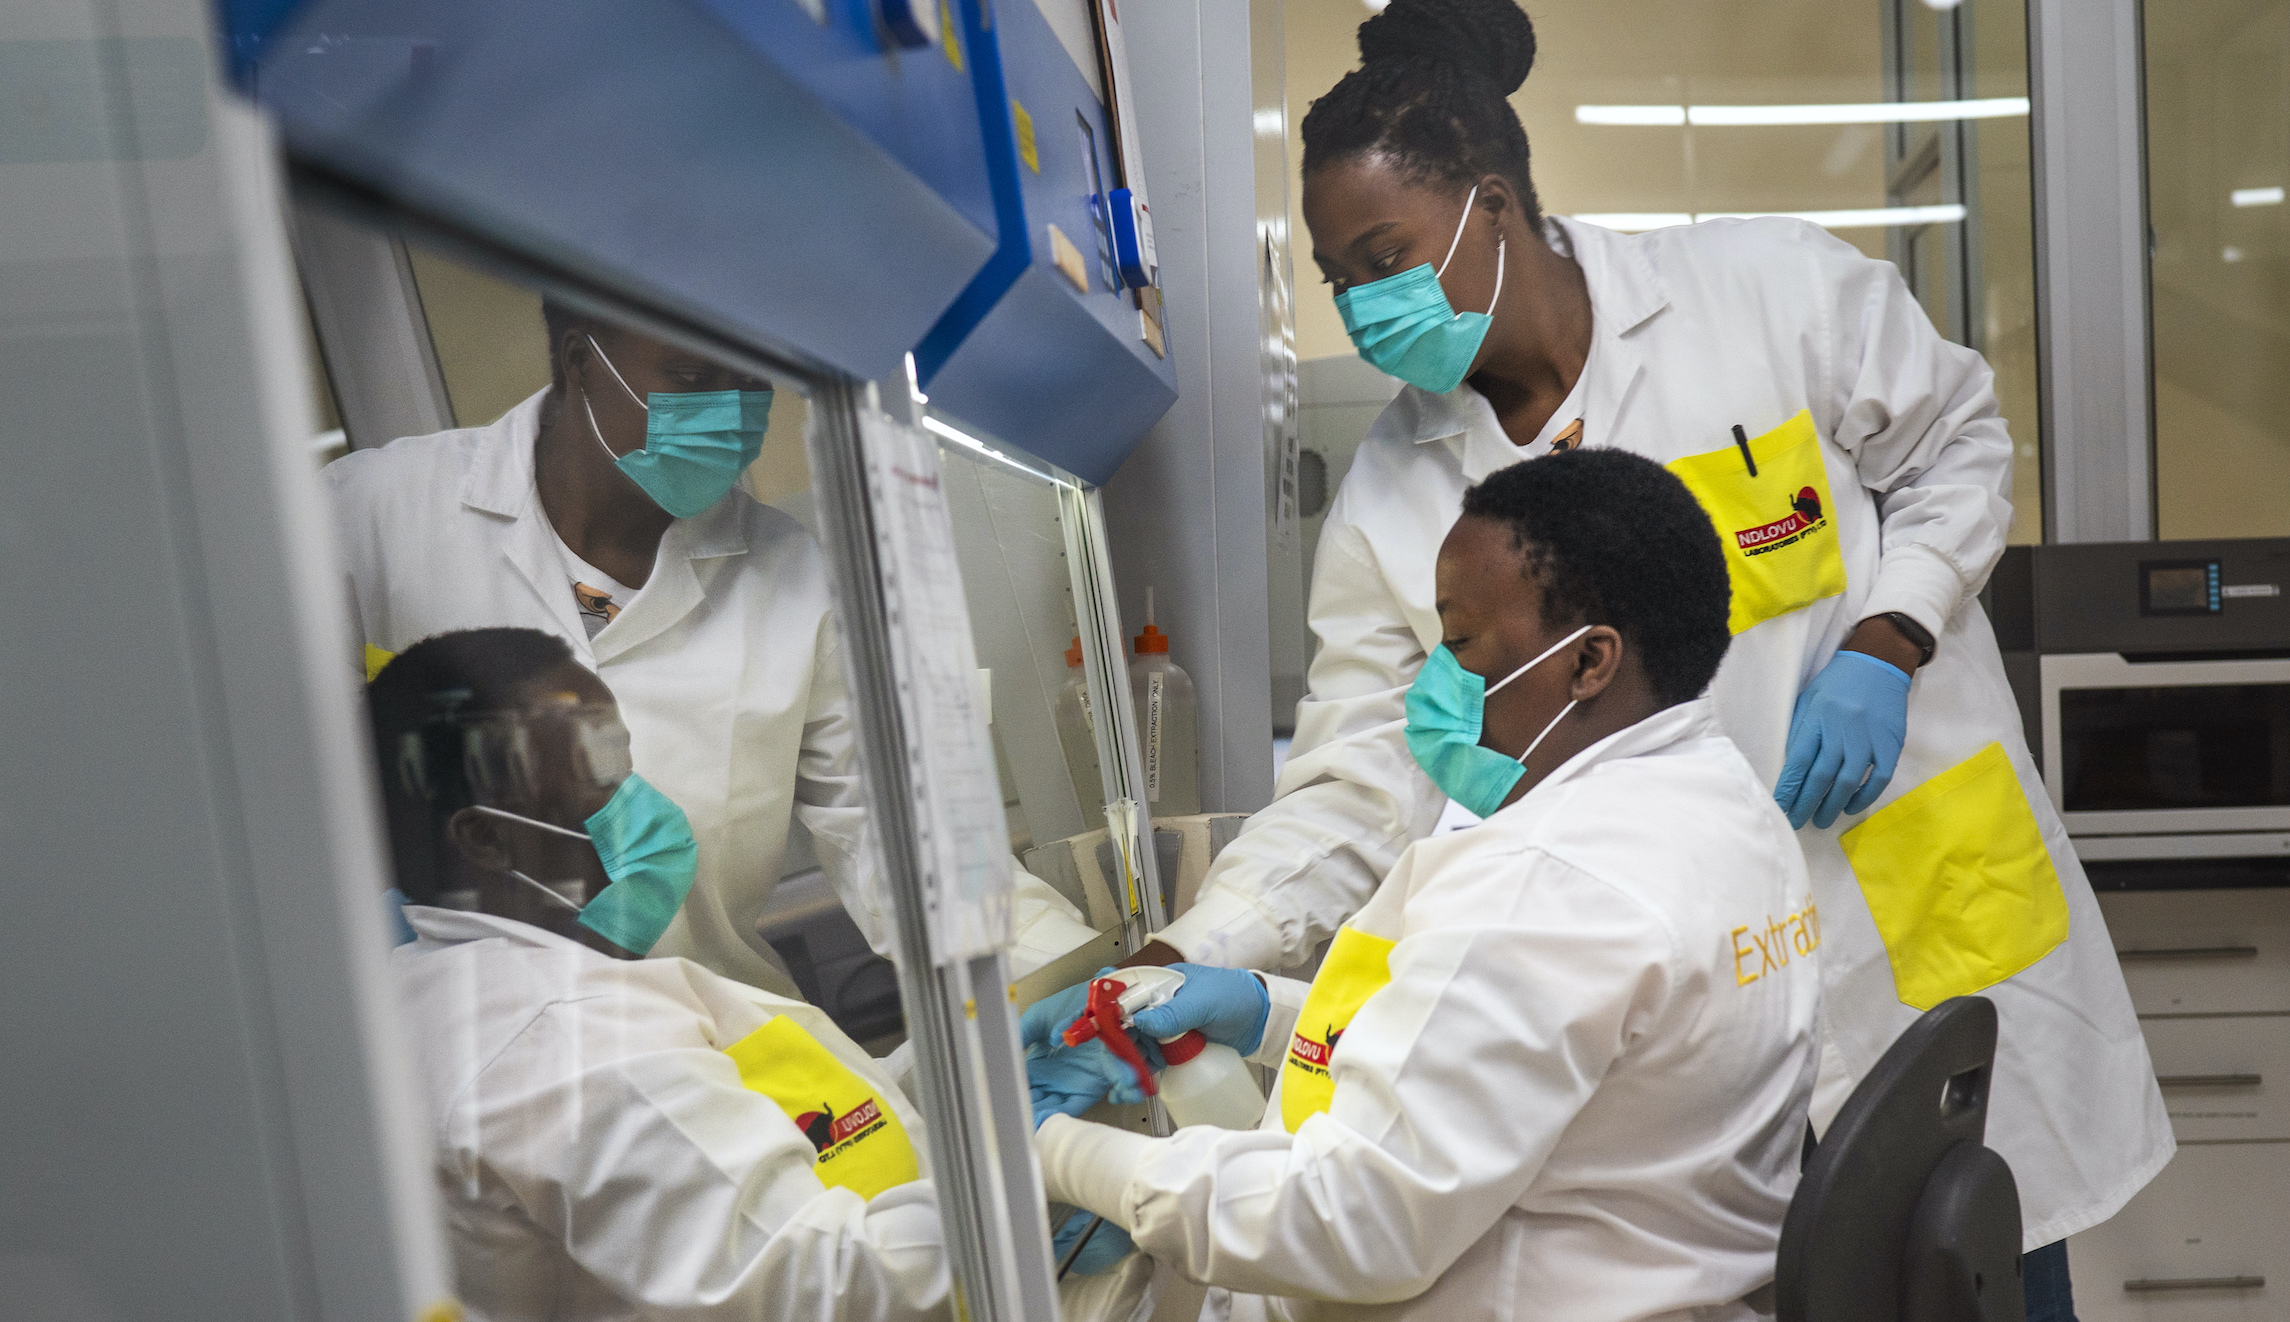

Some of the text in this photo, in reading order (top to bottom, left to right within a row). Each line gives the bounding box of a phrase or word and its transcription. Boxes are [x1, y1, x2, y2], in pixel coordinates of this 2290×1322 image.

[1738, 517, 1797, 547] NDLOVU
[1150, 701, 1158, 743] EXTRACTION
[1149, 745, 1157, 771] BLEACH
